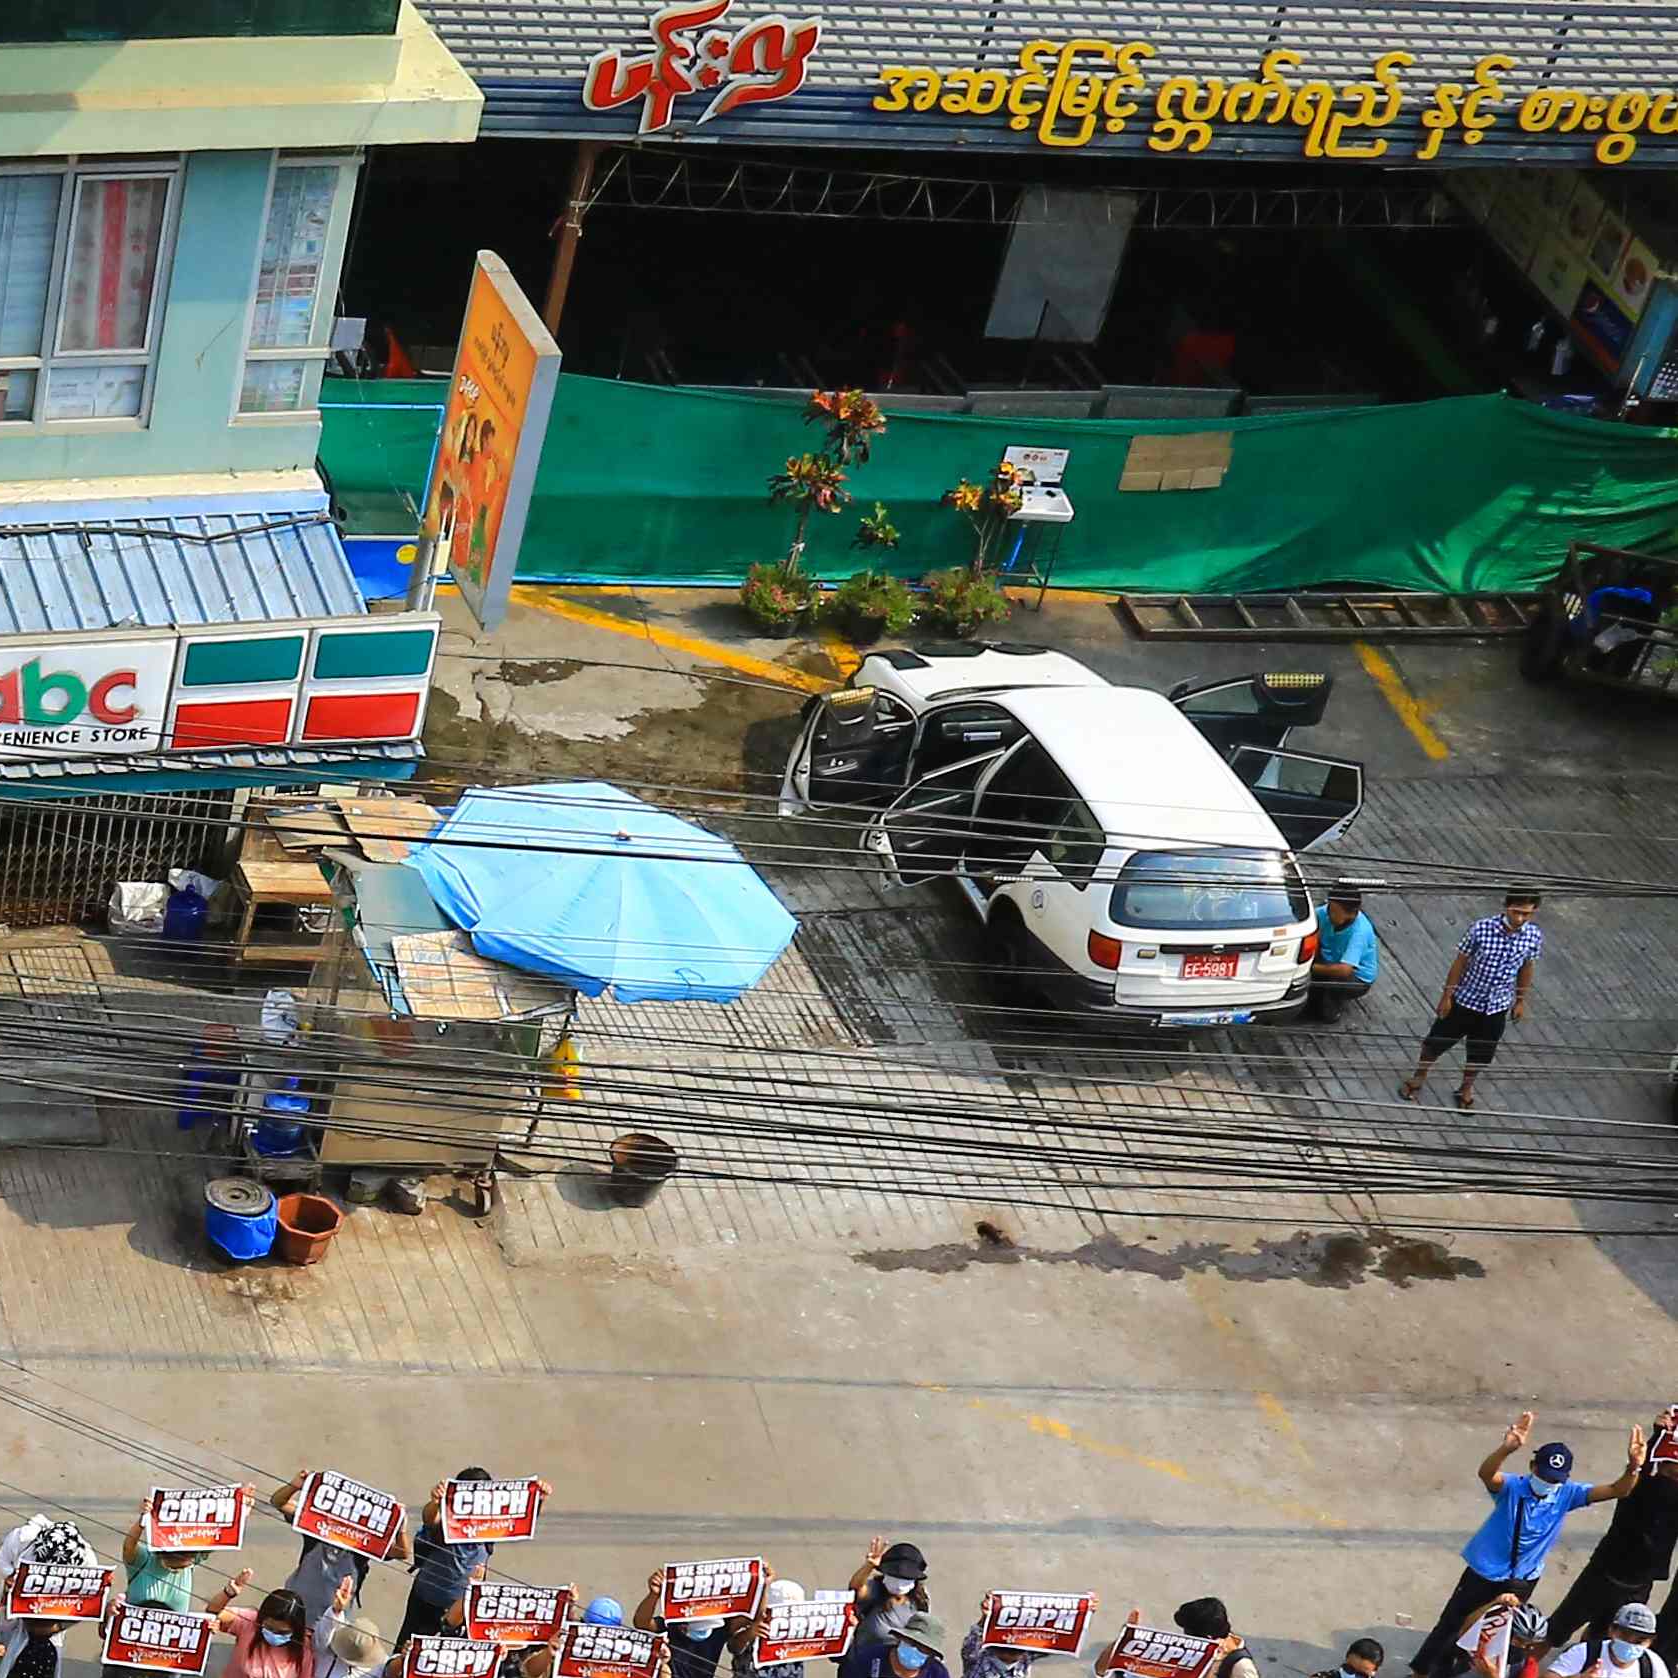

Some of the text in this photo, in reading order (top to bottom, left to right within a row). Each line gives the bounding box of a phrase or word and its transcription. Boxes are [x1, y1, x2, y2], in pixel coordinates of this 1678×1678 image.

[873, 39, 1155, 147] အဆင့်မြင့်
[92, 727, 150, 743] STORE
[323, 1473, 394, 1506] WE SUPPORT
[457, 1481, 529, 1491] WE SUPPORT
[159, 1498, 235, 1523] CRPH
[313, 1486, 392, 1530] CRPH
[453, 1490, 529, 1515] CRPH
[28, 1565, 104, 1579] WE SUPPORT
[676, 1562, 749, 1575] WE SUPPORT
[24, 1575, 102, 1596] CRPH
[674, 1572, 750, 1598] CRPH
[476, 1596, 555, 1619] CRPH
[1001, 1595, 1078, 1609] WE SUPPORT
[125, 1606, 203, 1628] WE SUPPORT
[770, 1614, 843, 1639] CRPH
[997, 1608, 1078, 1630] CRPH
[121, 1618, 201, 1647] CRPH
[417, 1649, 492, 1673] CRPH
[573, 1637, 653, 1663] CRPH
[1123, 1641, 1204, 1668] CRPH
